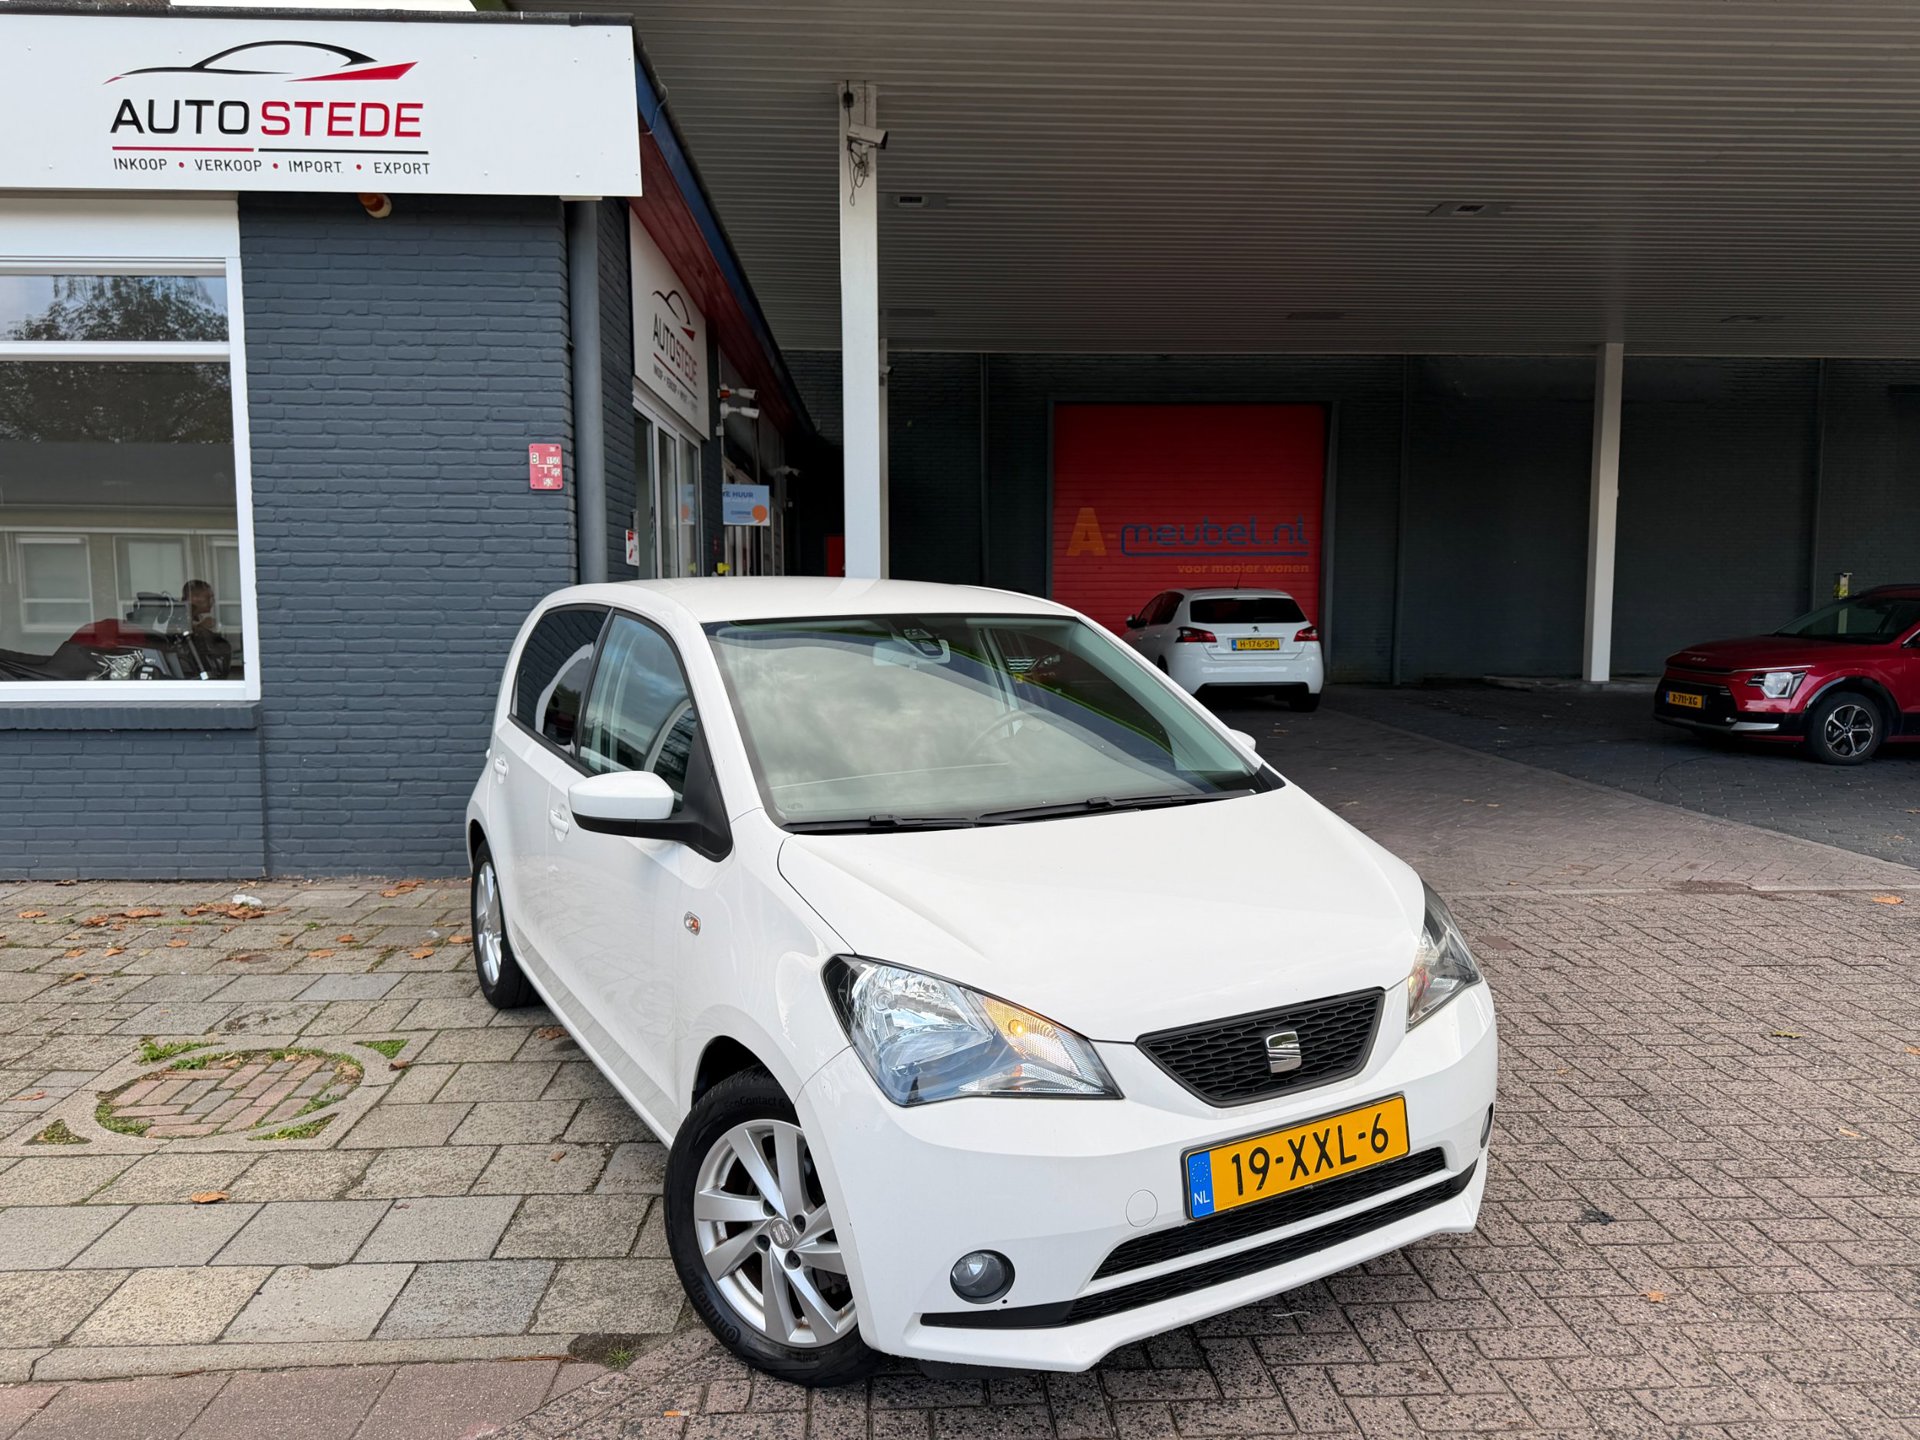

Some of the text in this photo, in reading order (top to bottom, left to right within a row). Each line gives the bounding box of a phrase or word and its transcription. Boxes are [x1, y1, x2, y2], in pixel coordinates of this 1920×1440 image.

[113, 158, 431, 175] INKOOP VERKOOP IMPORT EXPORT
[1177, 562, 1309, 574] voor mooier wonen
[1240, 640, 1275, 648] H-176-SP
[1231, 1113, 1389, 1196] 19-XXL-6
[1194, 1190, 1211, 1206] NL
